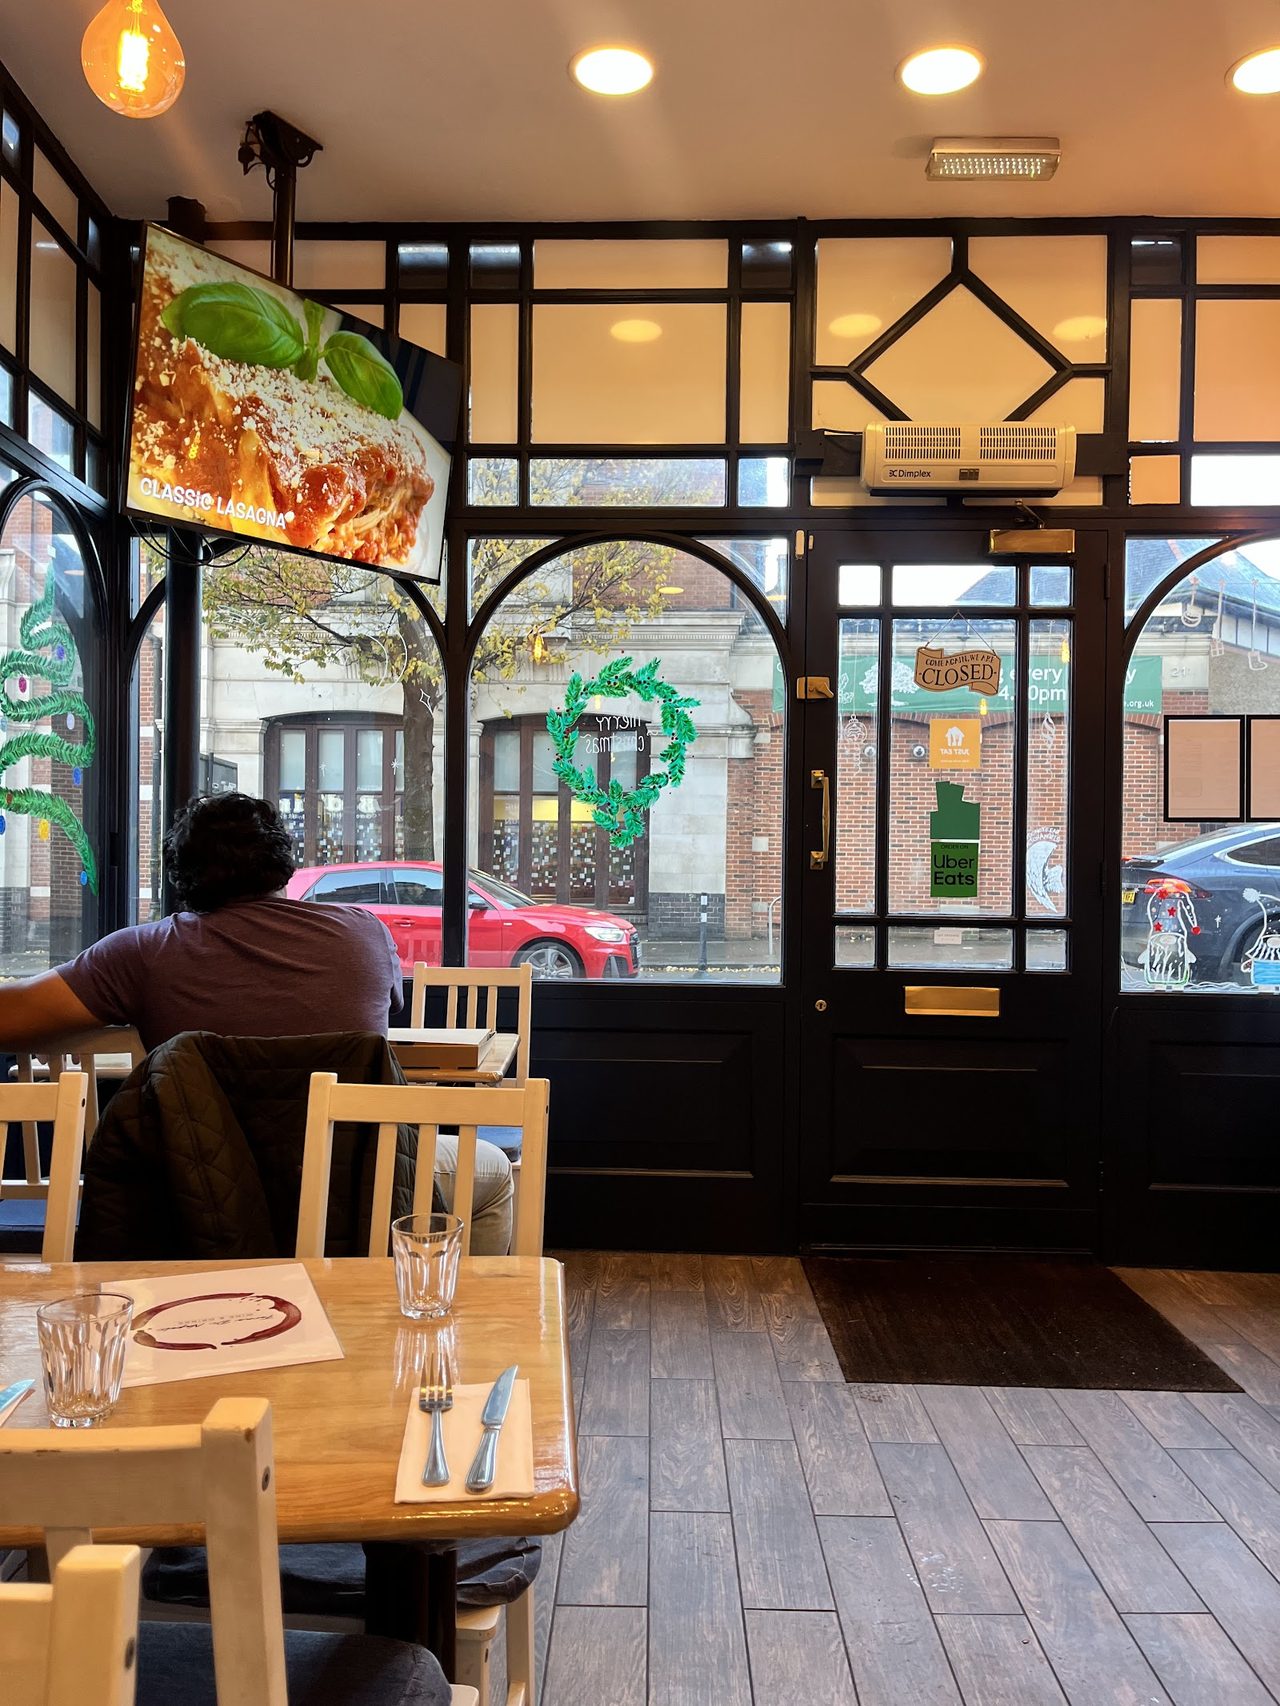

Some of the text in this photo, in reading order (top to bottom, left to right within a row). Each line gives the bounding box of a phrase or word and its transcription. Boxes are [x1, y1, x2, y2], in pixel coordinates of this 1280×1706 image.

[898, 469, 931, 478] Dimplex
[216, 496, 287, 530] LASAGNA
[925, 658, 943, 667] COME
[980, 654, 995, 664] ARE
[922, 663, 994, 686] CLOSED
[933, 854, 975, 869] Uber
[933, 871, 975, 886] Eats
